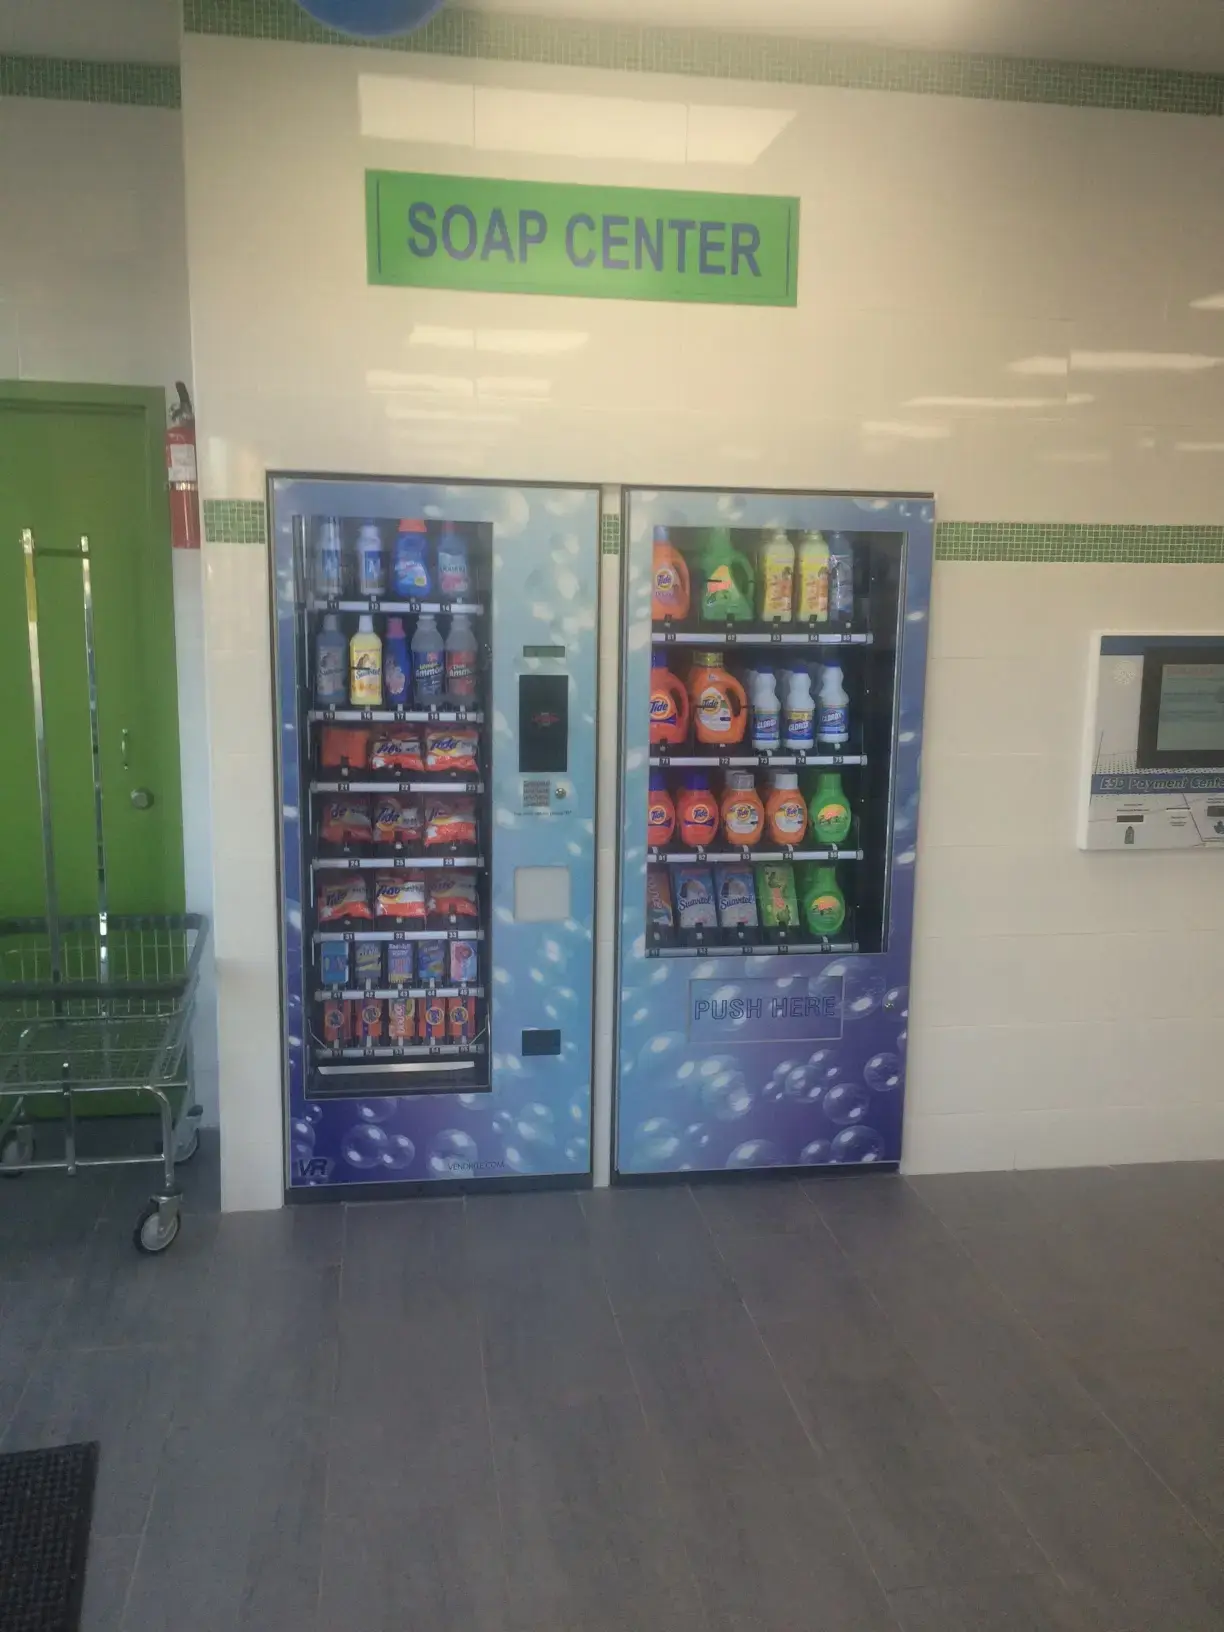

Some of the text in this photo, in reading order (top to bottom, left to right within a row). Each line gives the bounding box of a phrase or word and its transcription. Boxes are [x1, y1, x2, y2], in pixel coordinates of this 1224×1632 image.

[406, 200, 764, 279] SOAP CENTER
[649, 701, 669, 714] Tide
[703, 696, 719, 708] Tide
[1100, 776, 1126, 790] ESD
[1128, 775, 1189, 792] Payment
[650, 810, 665, 821] Tide
[693, 809, 708, 821] Tide
[736, 808, 750, 818] Tide
[786, 806, 798, 816] Tide
[678, 893, 713, 912] Suavitel
[719, 894, 754, 912] Suavitel
[694, 995, 837, 1021] PUSH HERE
[298, 1158, 328, 1177] VR
